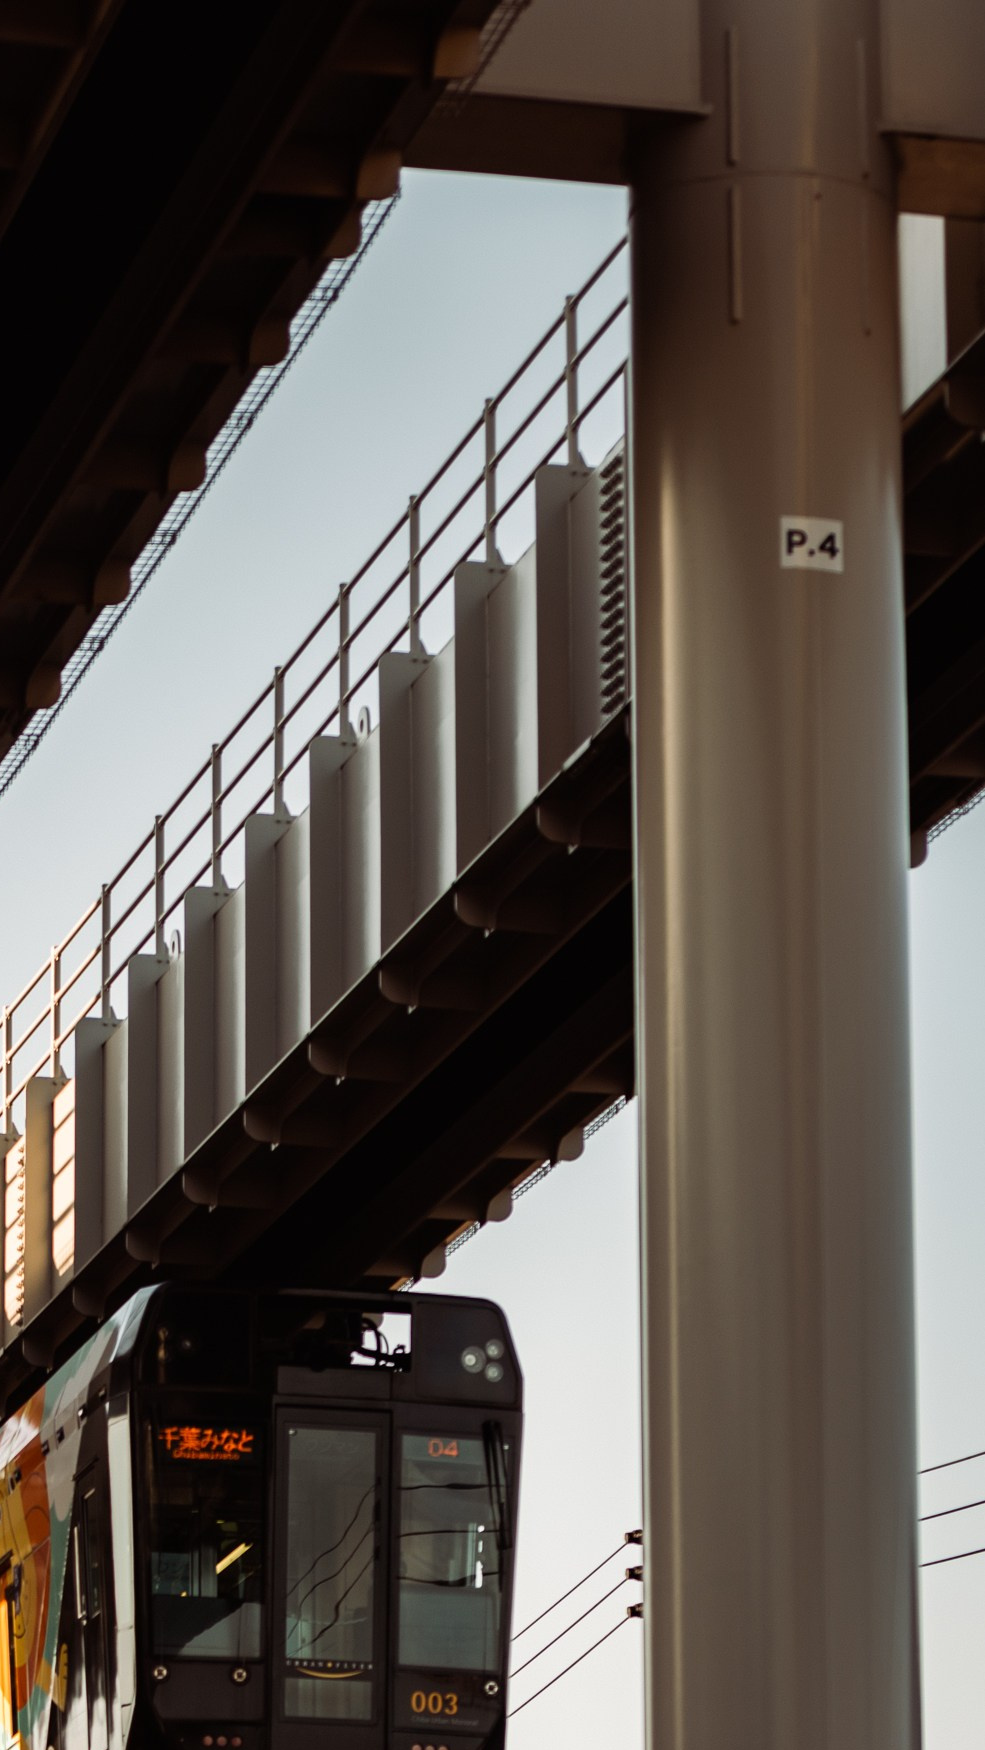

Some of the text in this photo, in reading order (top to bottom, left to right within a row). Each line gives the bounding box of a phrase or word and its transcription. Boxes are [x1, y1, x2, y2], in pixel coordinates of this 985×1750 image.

[786, 528, 839, 560] P.4
[158, 1425, 254, 1453] 千葉みなと
[427, 1438, 459, 1458] 04
[410, 1690, 459, 1715] 003
